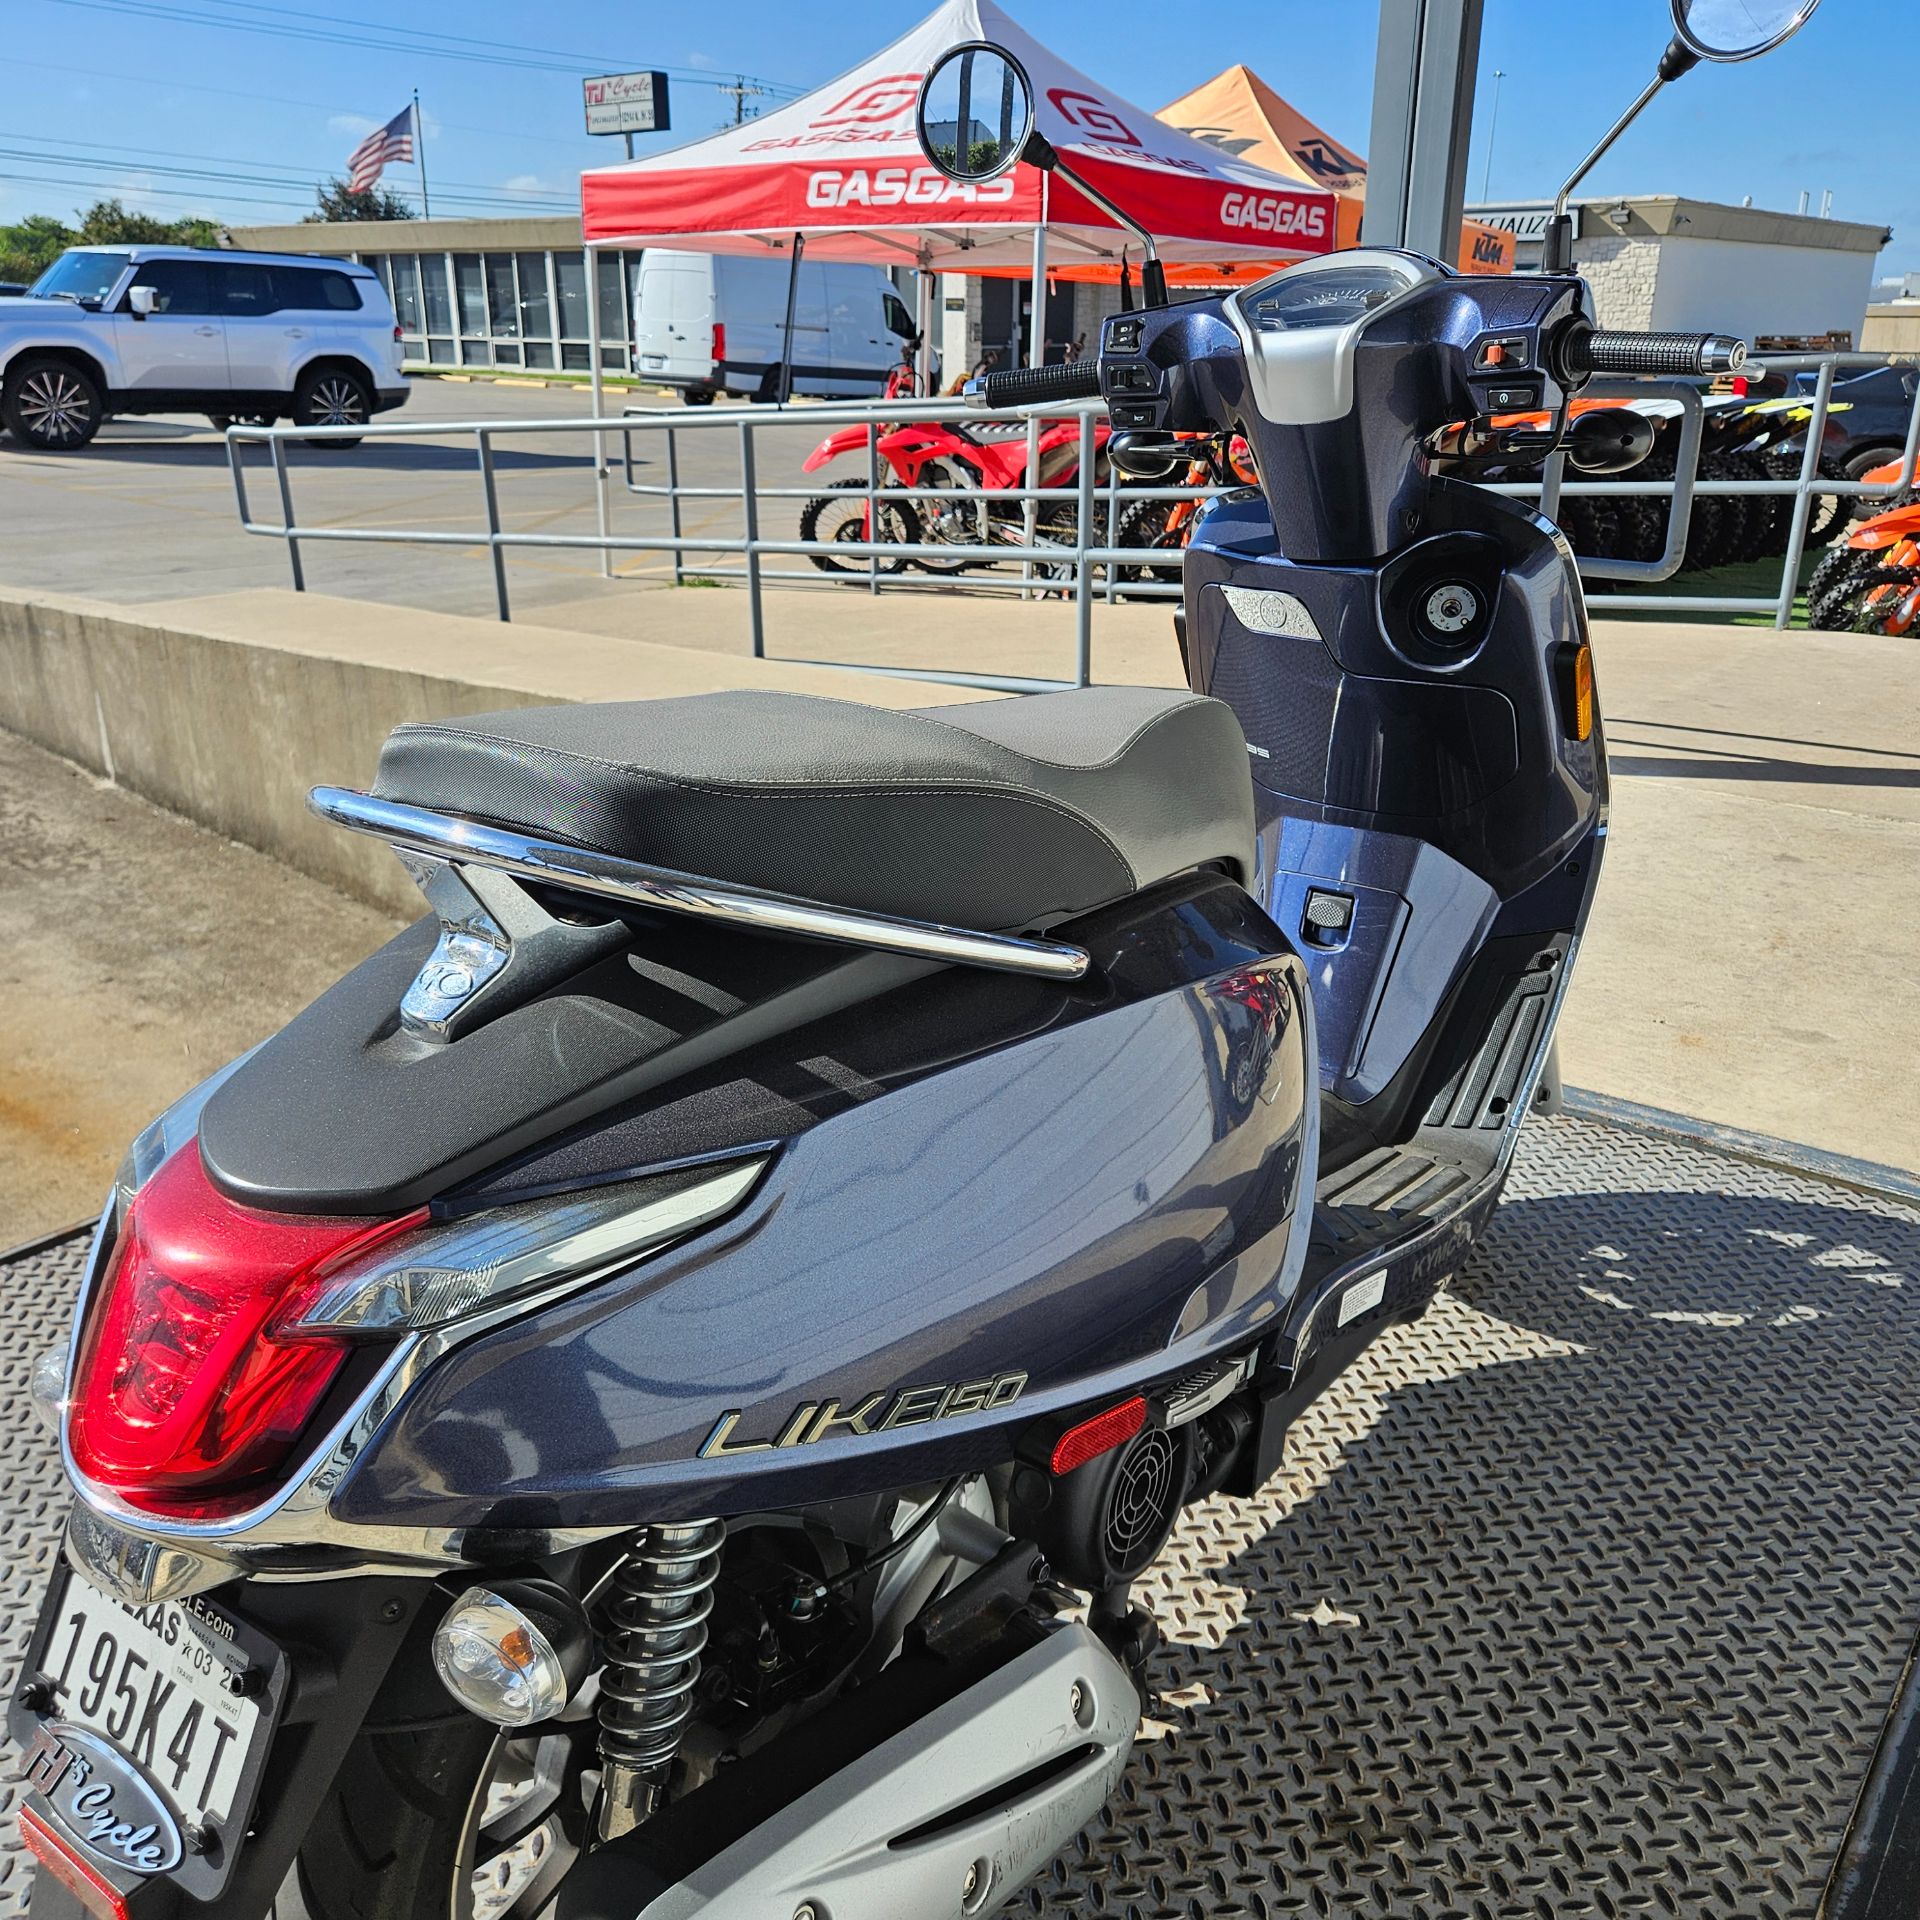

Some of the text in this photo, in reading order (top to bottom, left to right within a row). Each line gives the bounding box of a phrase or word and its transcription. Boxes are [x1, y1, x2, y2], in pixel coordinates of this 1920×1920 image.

[739, 129, 918, 152] GASGAS
[806, 165, 1017, 208] GASGAS
[1220, 192, 1326, 238] GASGAS
[1472, 232, 1504, 265] KTM
[194, 1647, 213, 1675] 03
[55, 1611, 239, 1814] 195K4T
[71, 1782, 163, 1869] Cycle
